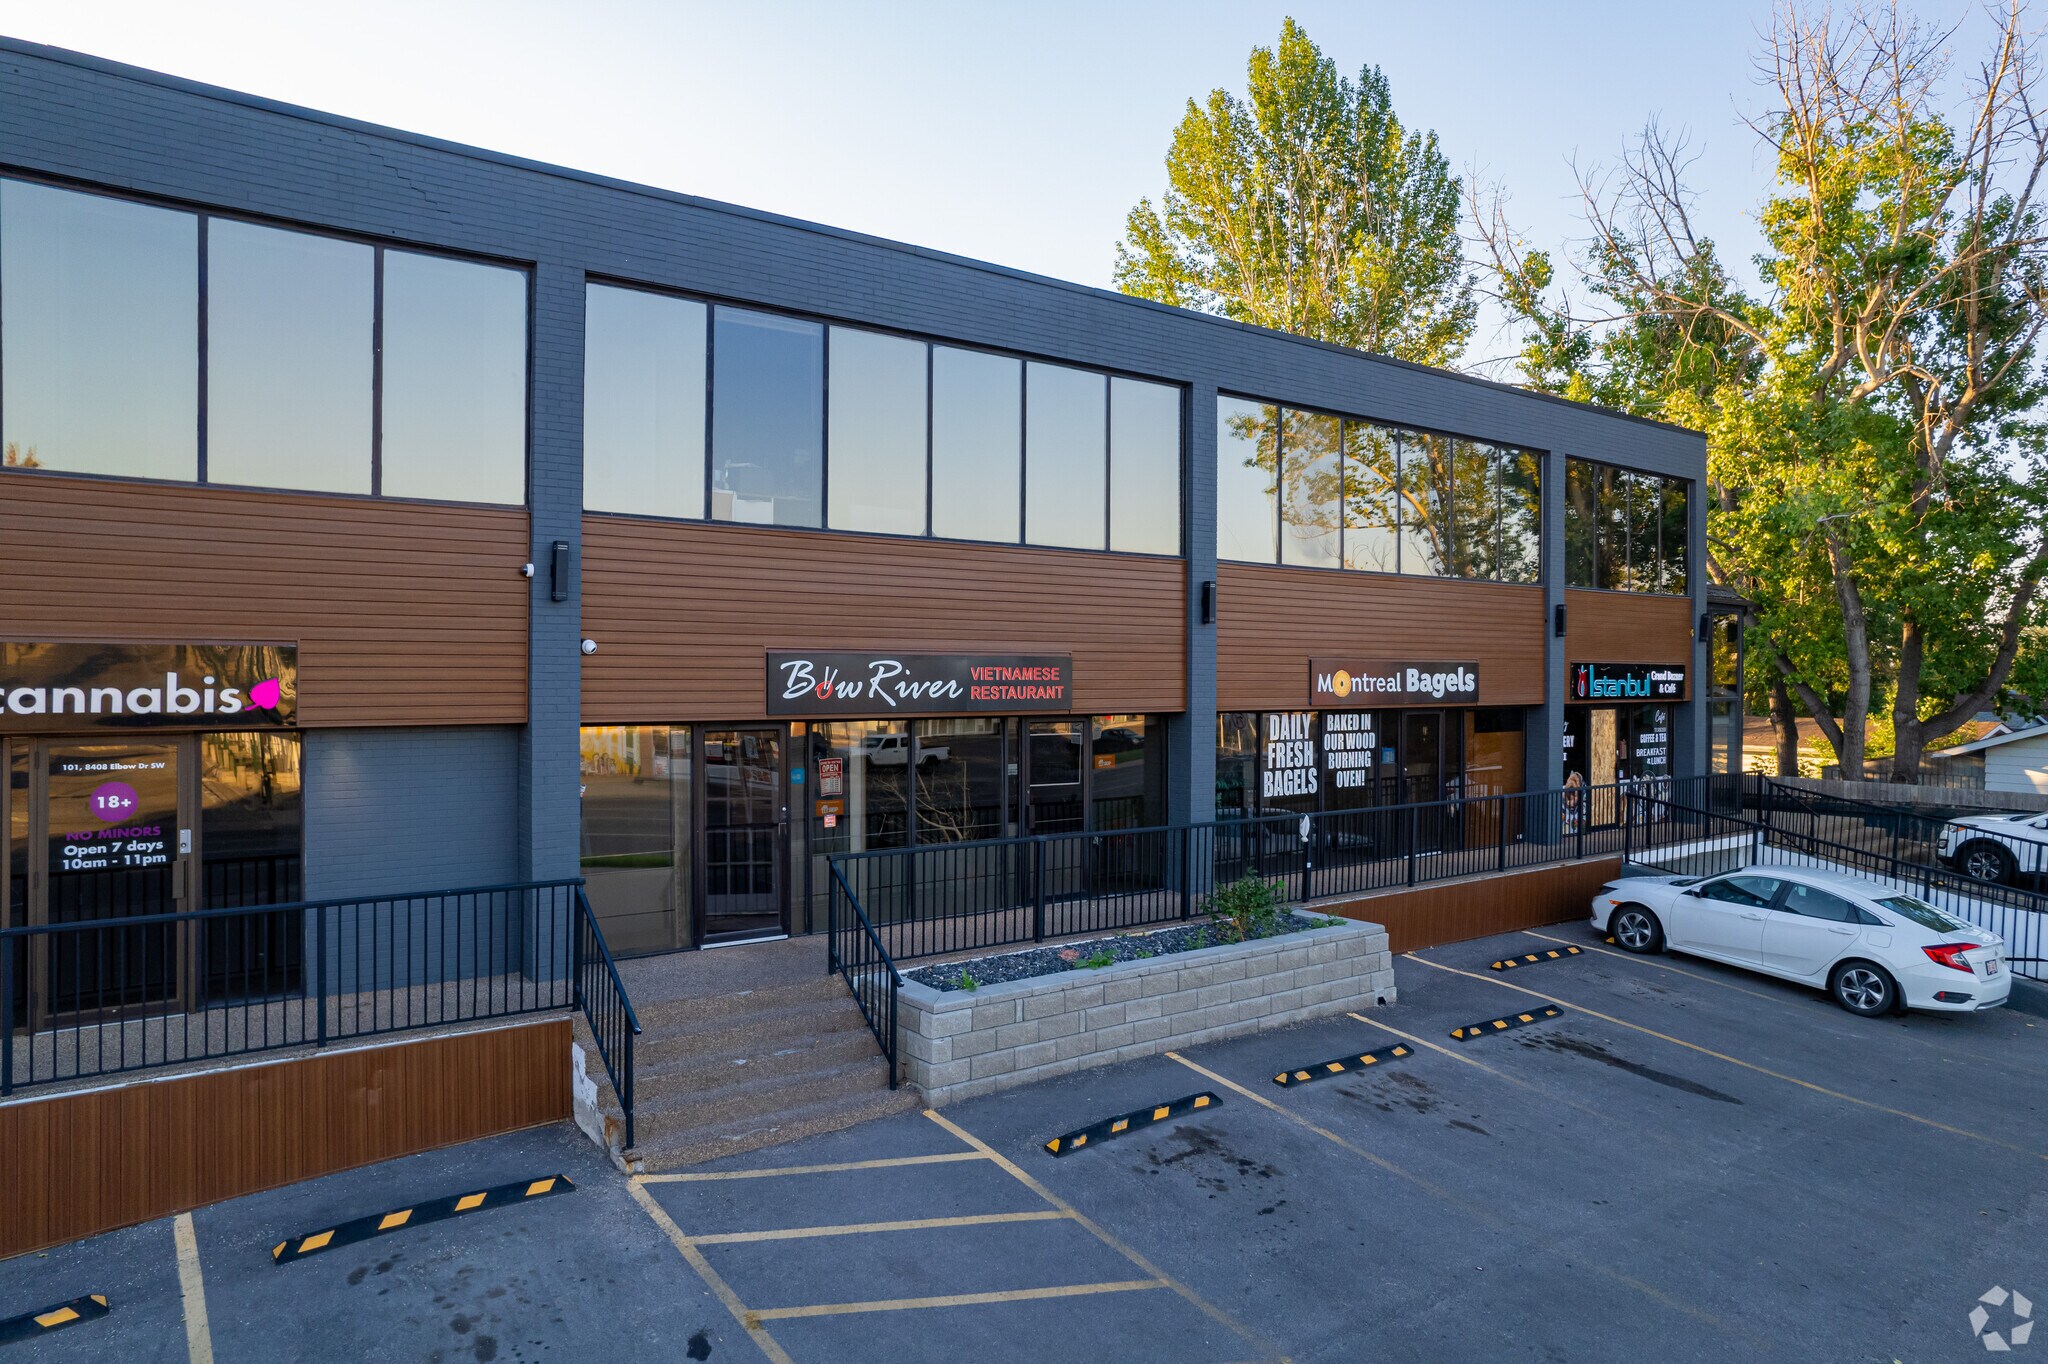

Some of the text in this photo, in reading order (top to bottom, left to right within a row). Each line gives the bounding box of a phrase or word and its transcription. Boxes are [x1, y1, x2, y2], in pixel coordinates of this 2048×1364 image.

[970, 666, 1060, 682] VIETNAMESE
[1317, 666, 1475, 698] Montreal Bagels
[1589, 664, 1651, 697] Istanbul
[780, 660, 964, 707] Bow River
[970, 685, 1064, 700] RESTAURANT
[0, 671, 243, 715] annabis
[1269, 713, 1312, 741] DAILY
[1327, 713, 1371, 731] BAKED IN
[1324, 732, 1376, 751] OUR WOOD
[1640, 733, 1655, 743] COFFEE
[1267, 741, 1314, 769] FRESH
[1328, 750, 1372, 769] BURNING
[1636, 747, 1667, 757] BREAKFAST
[1651, 757, 1666, 765] LUNCH
[62, 764, 82, 772] 101,
[822, 764, 839, 773] OPEN
[1263, 767, 1318, 798] BAGELS
[1336, 769, 1366, 788] OVEN!
[97, 795, 132, 809] 18+
[65, 826, 161, 841] NO MINORS
[63, 840, 164, 858] Open 7 days
[63, 858, 107, 870] 10am
[124, 854, 167, 867] 11pm
